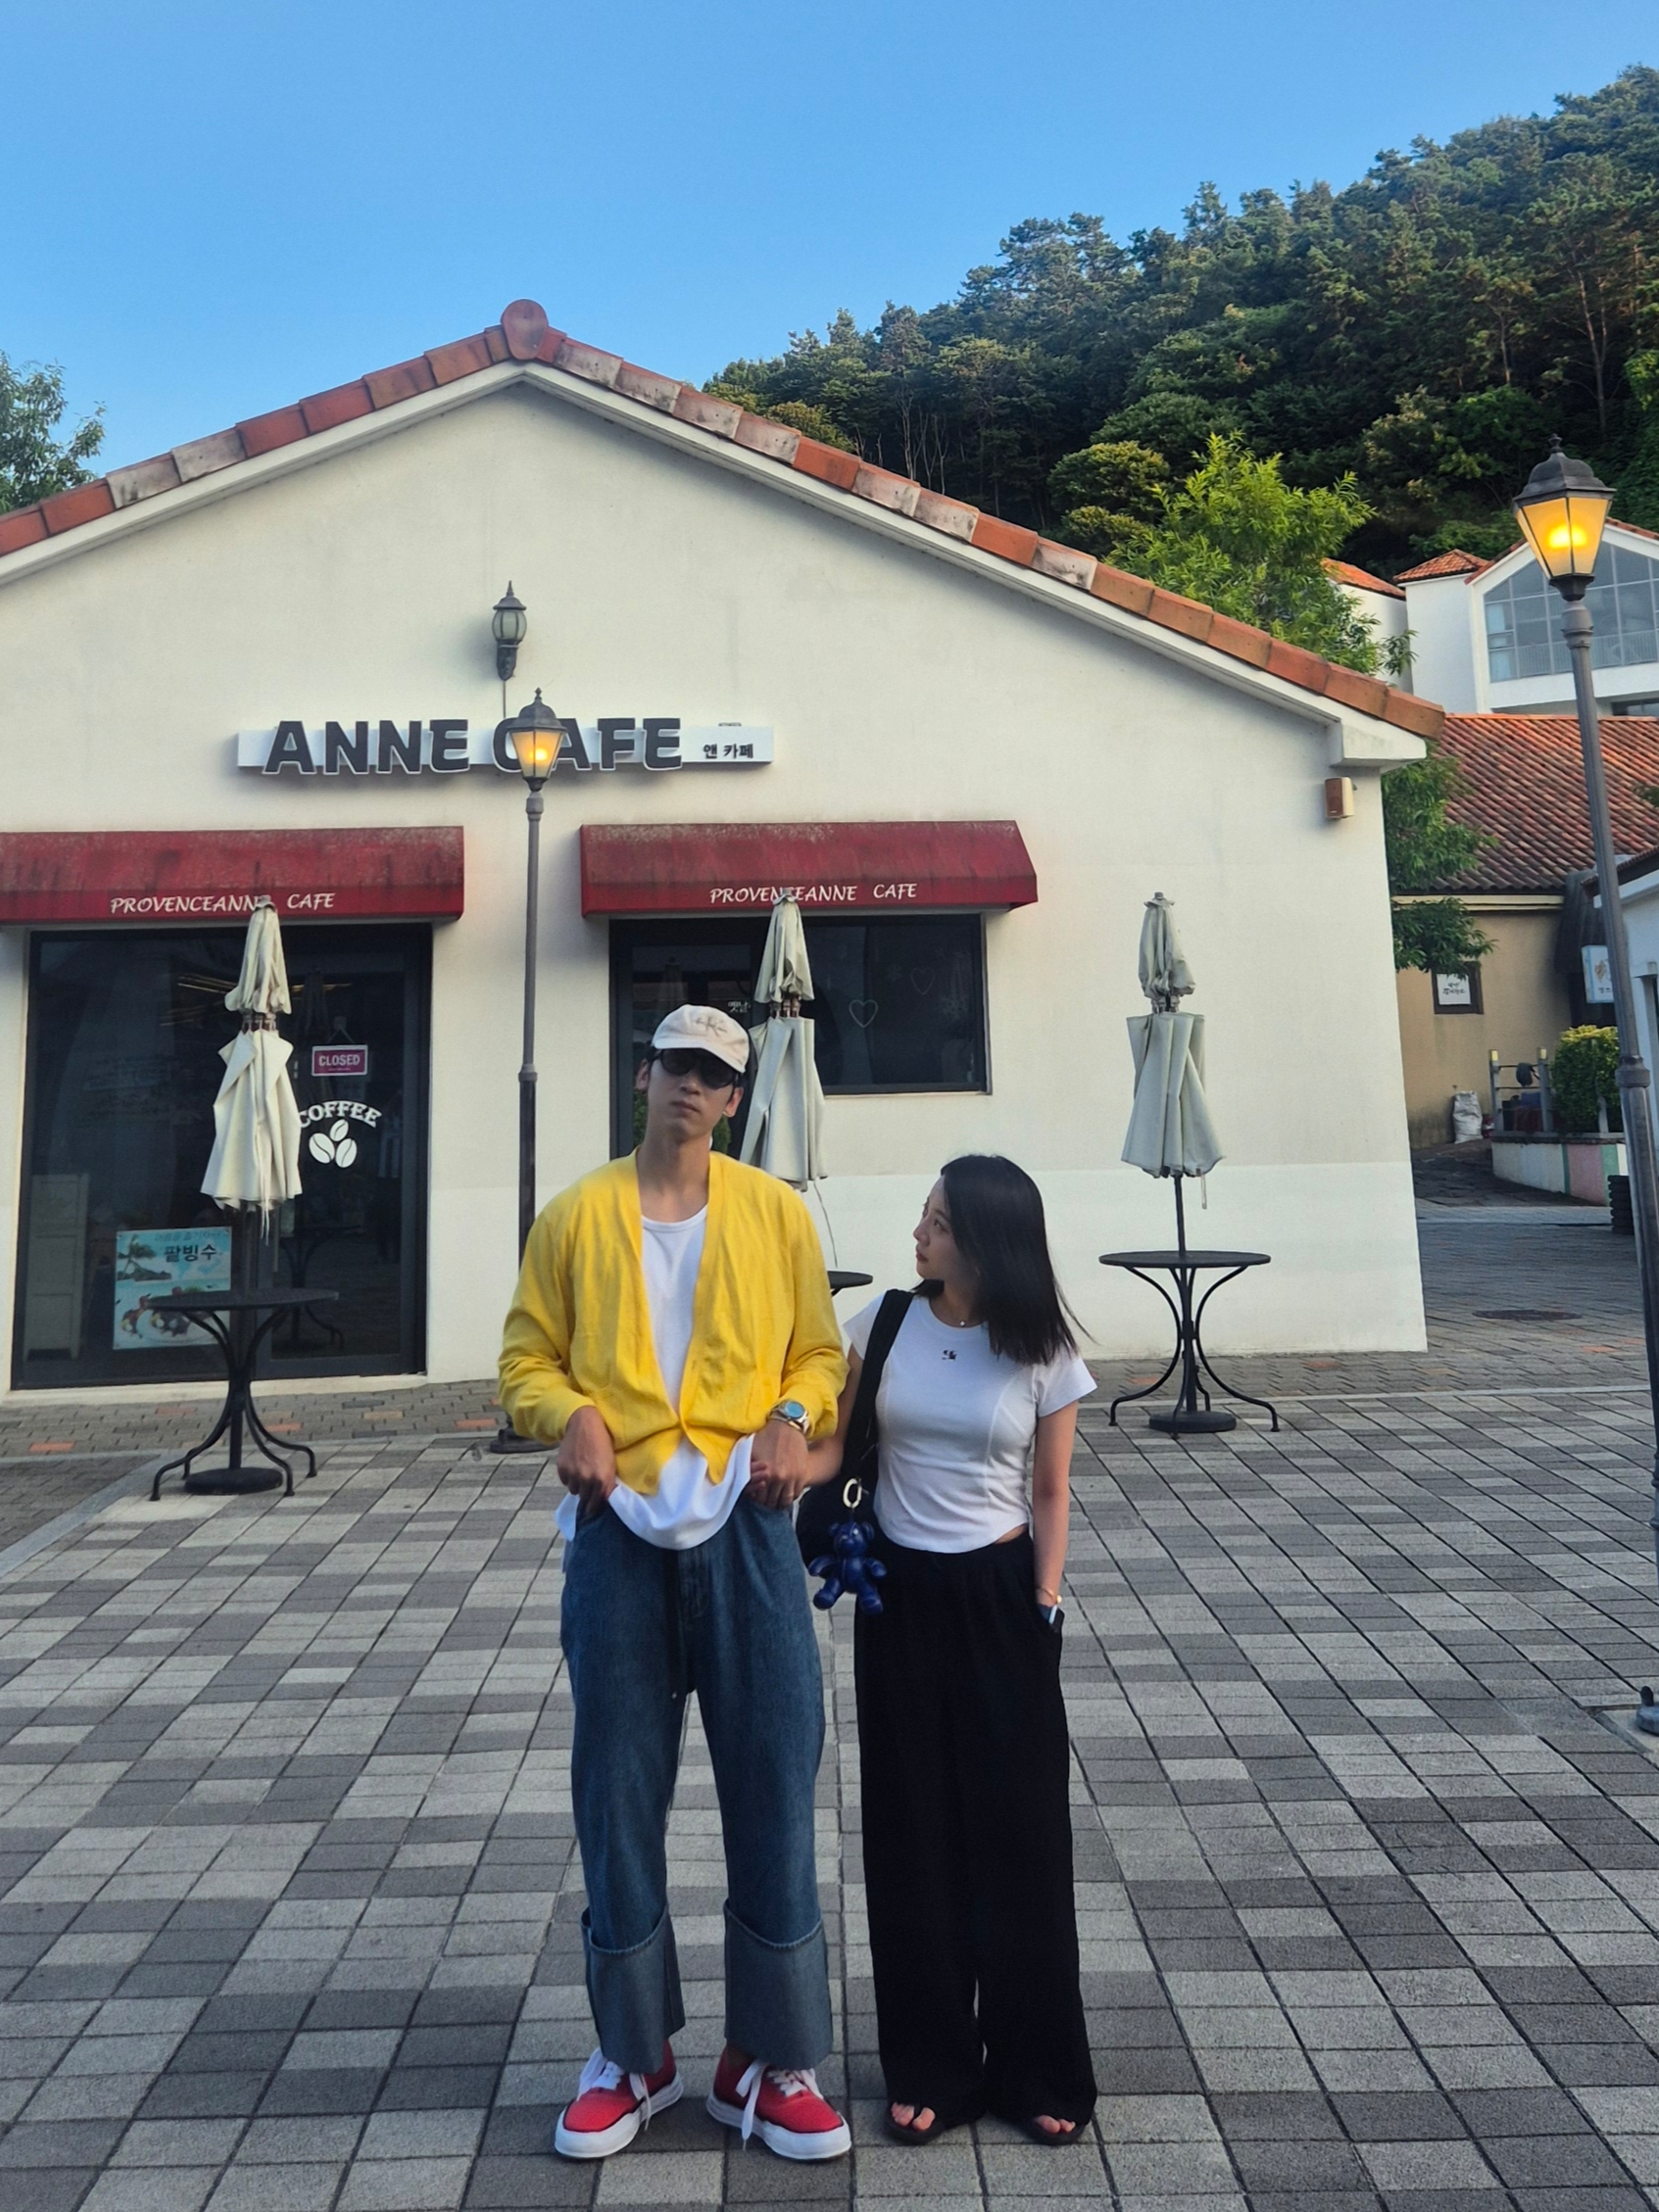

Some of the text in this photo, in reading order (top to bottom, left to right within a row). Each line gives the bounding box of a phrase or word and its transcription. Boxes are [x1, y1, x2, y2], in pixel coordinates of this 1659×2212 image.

[262, 719, 470, 775] ANNE
[703, 743, 754, 759] 앤 카페
[111, 892, 335, 913] PROVENCEANN CAFE
[709, 883, 917, 903] PROVENEANNE CAFE
[318, 1054, 361, 1067] CLOSED
[298, 1100, 382, 1129] COFFEE
